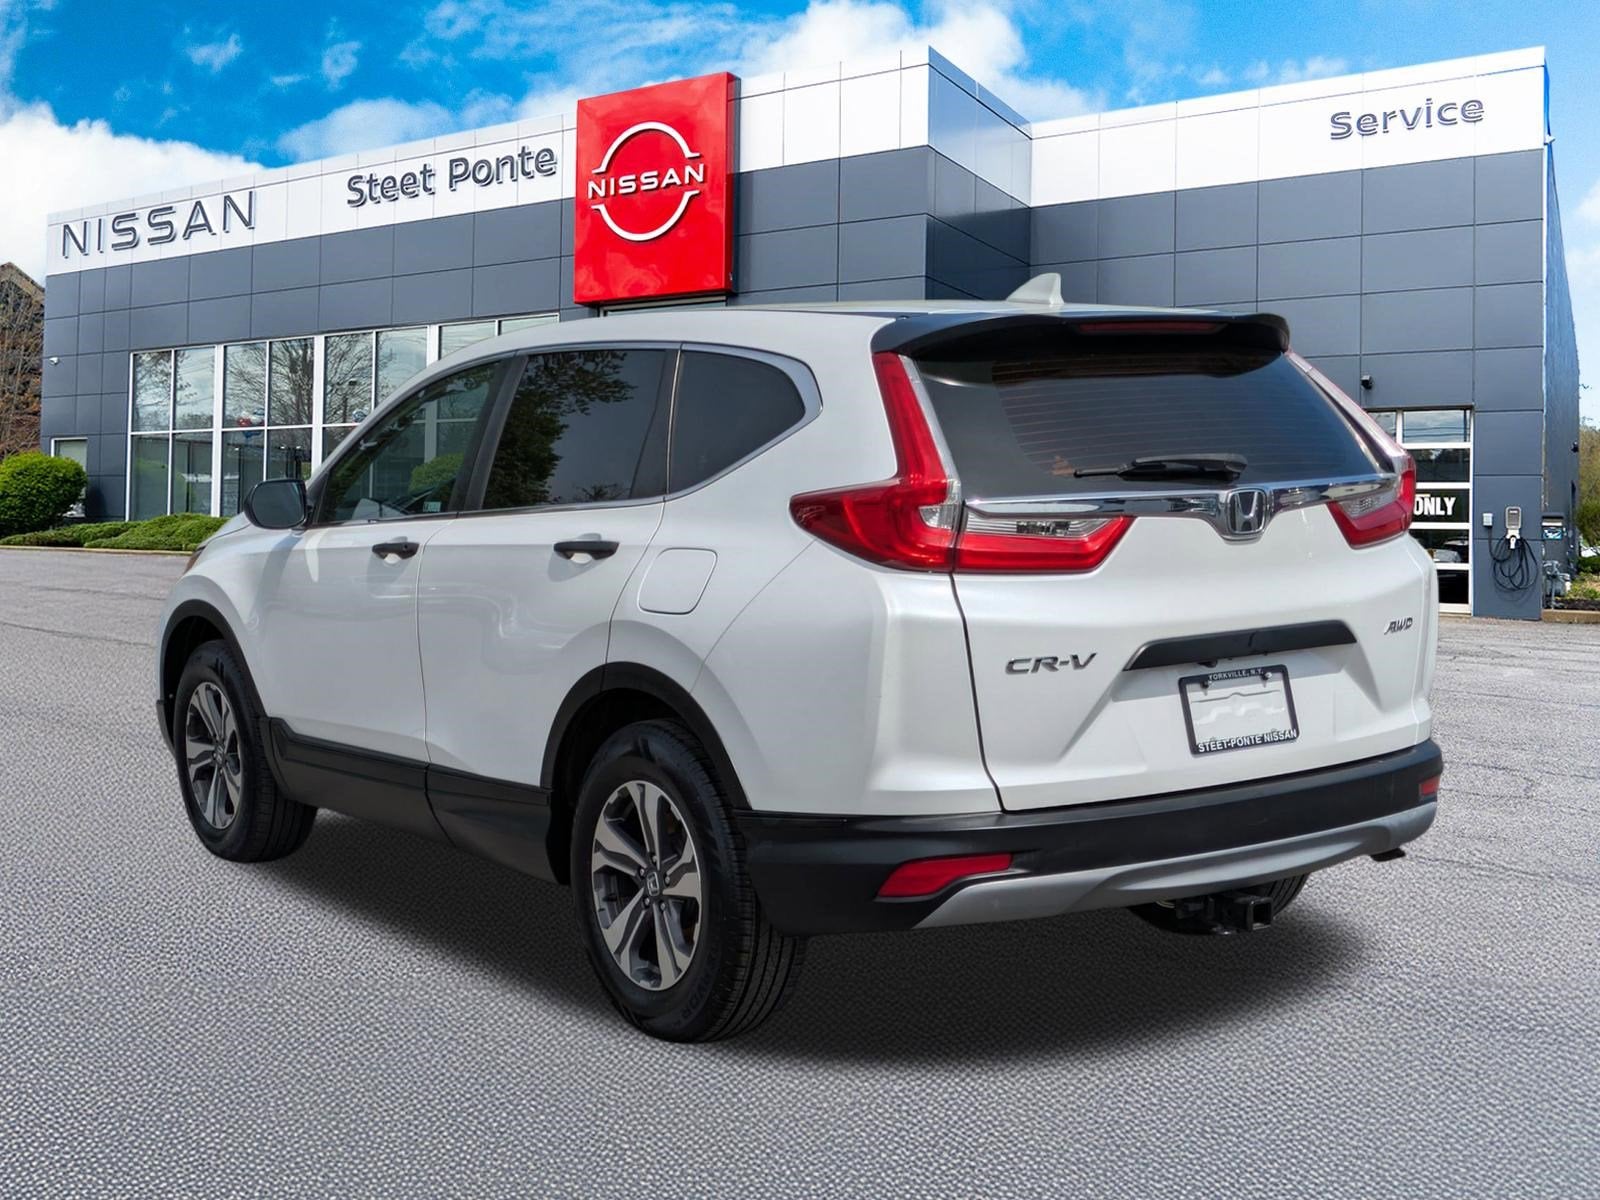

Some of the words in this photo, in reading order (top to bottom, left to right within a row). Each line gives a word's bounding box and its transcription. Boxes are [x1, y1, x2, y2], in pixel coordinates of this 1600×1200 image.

[1329, 98, 1484, 140] Service
[346, 162, 436, 206] Steet
[447, 145, 558, 192] Ponte
[587, 163, 705, 200] NISSAN
[62, 190, 255, 259] NISSAN
[1413, 496, 1456, 516] ONLY
[1383, 617, 1413, 635] AWD
[1005, 652, 1097, 675] CR-V
[1198, 734, 1262, 752] STEET-PONTE
[1264, 729, 1297, 742] NISSAN
